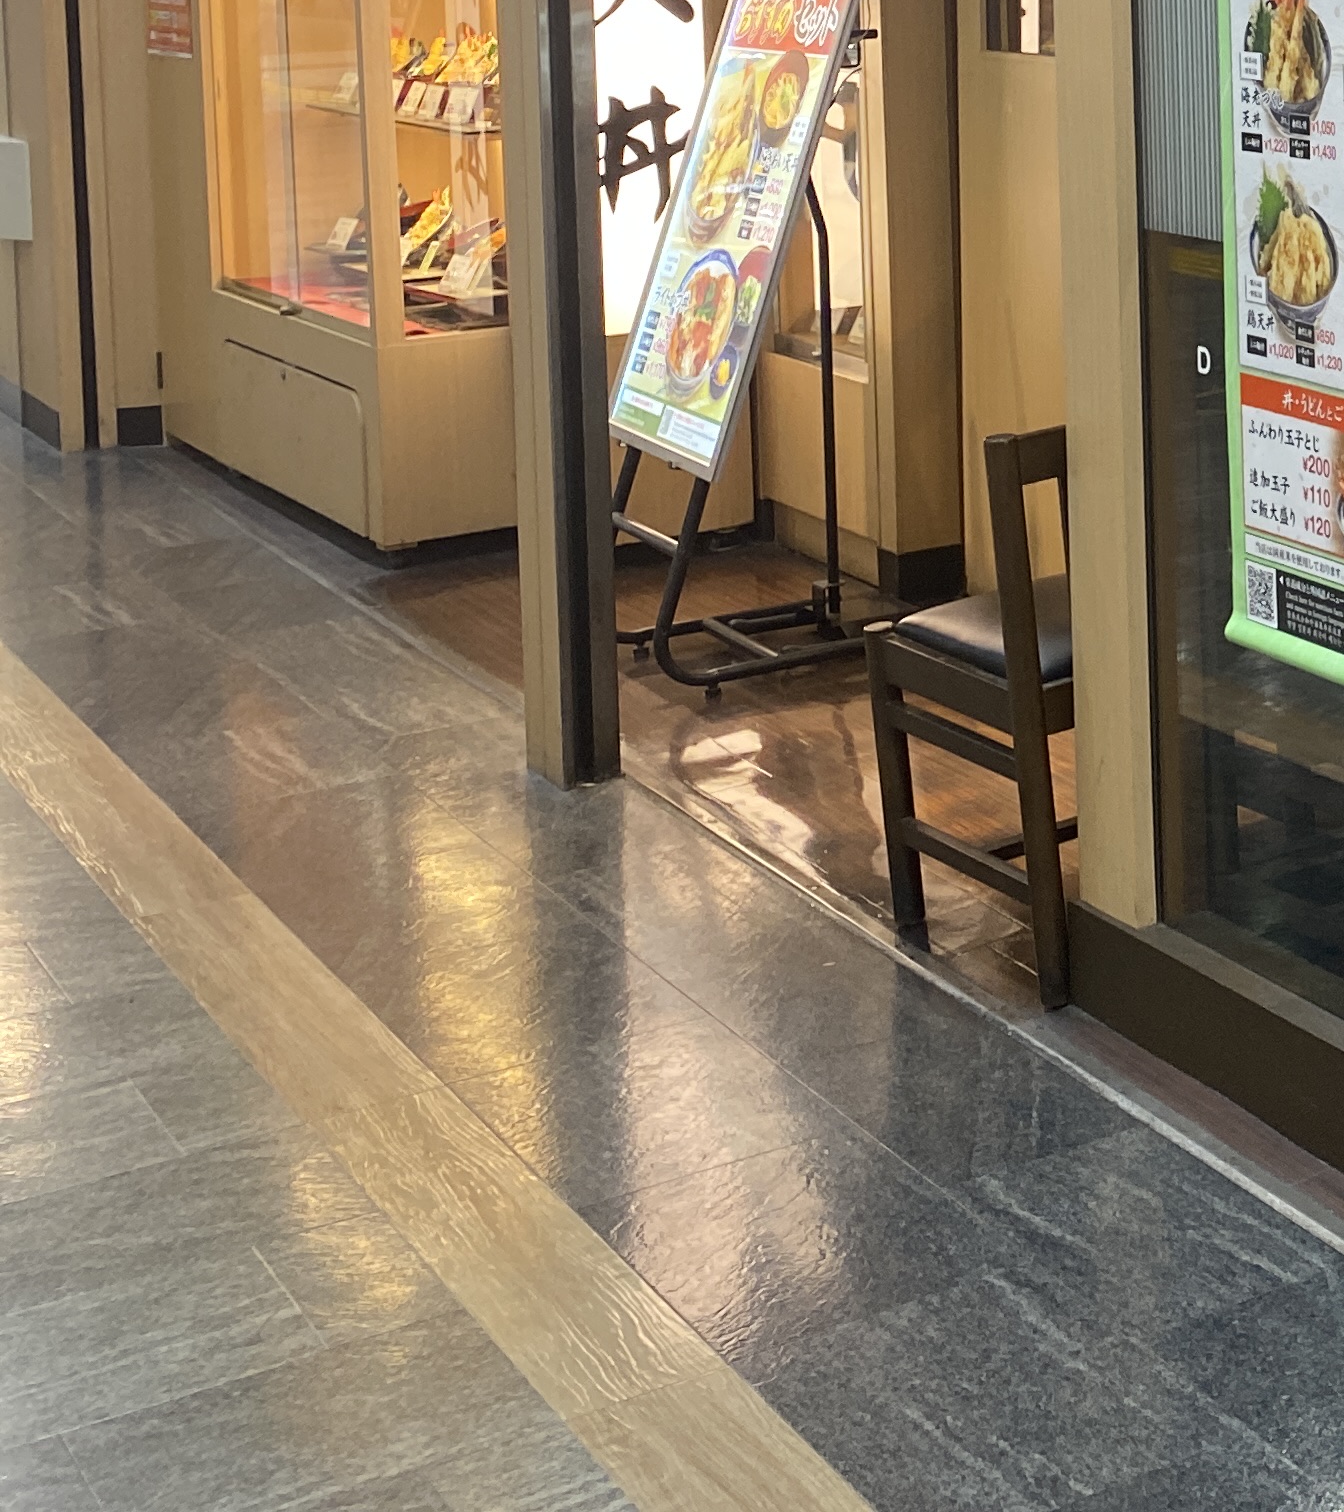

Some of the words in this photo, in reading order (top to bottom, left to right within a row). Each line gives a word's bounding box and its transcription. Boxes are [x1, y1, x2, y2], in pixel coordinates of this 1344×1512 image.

[1248, 420, 1320, 452] ふんわり玉子とじ
[1303, 456, 1330, 478] ¥200
[1250, 468, 1290, 495] 追加玉子
[1304, 486, 1330, 508] ¥110
[1250, 499, 1296, 528] ご飯大盛り
[1304, 516, 1331, 539] ¥120
